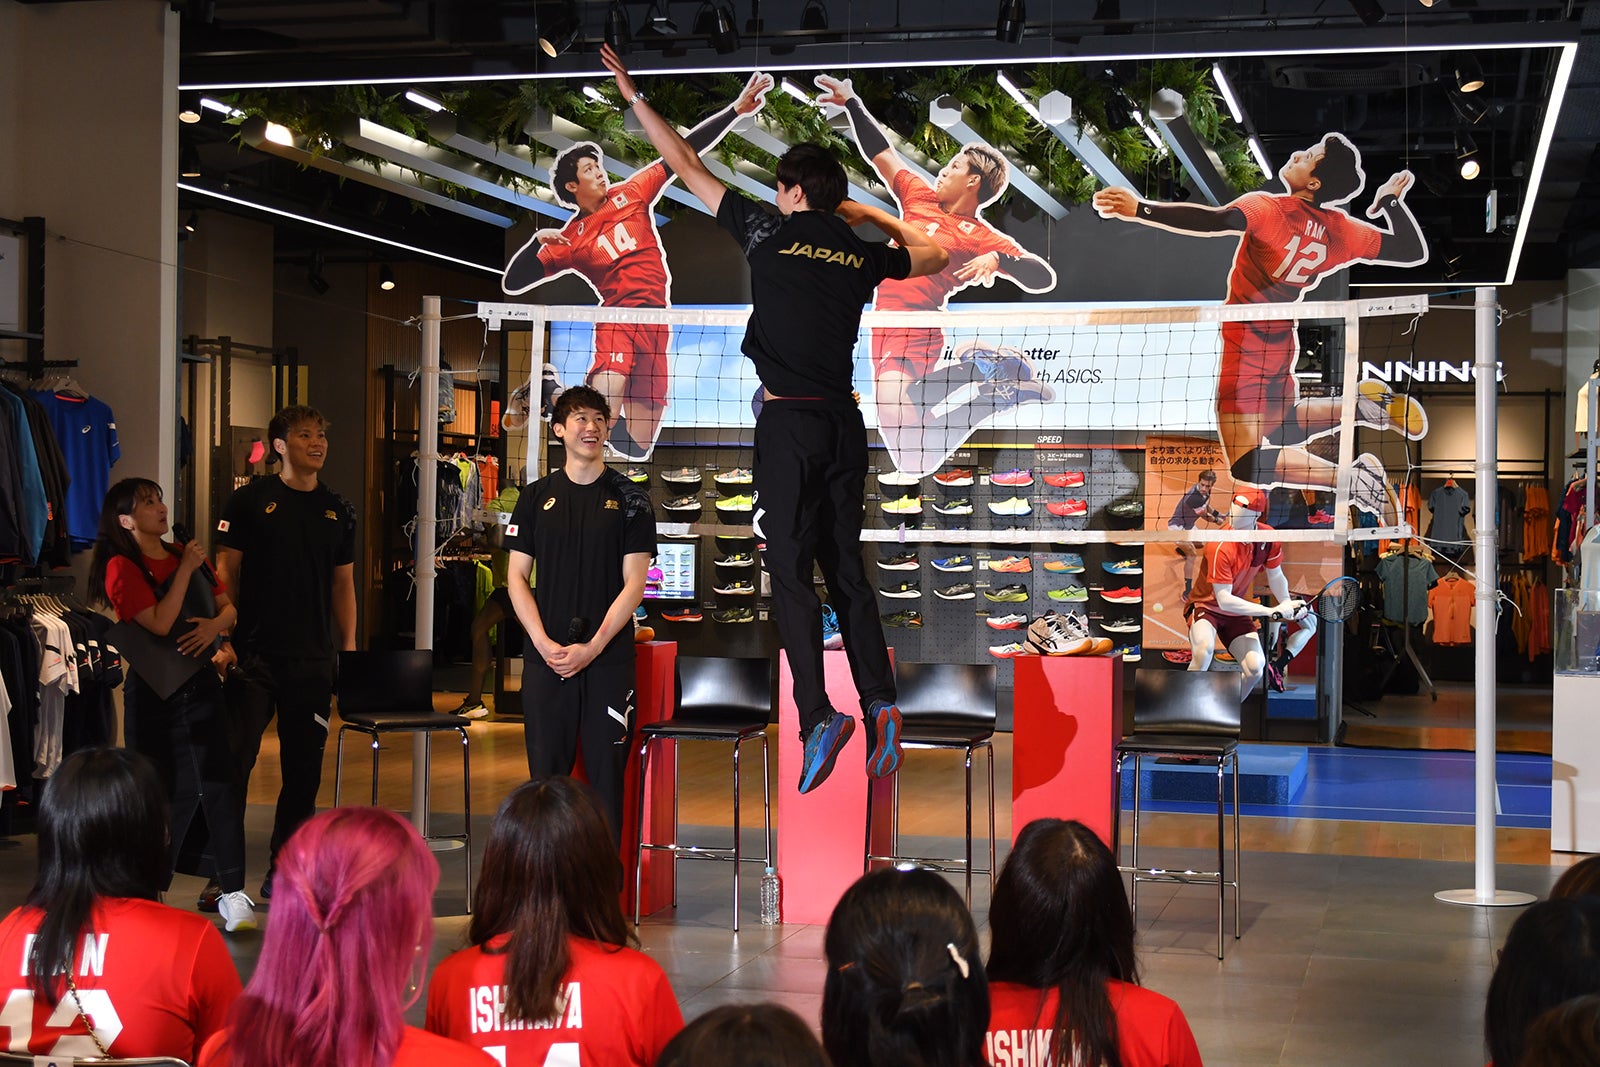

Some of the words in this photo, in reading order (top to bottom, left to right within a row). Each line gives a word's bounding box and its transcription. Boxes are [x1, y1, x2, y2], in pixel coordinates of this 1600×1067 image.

[1304, 220, 1326, 240] RAN
[597, 222, 637, 261] 14
[778, 242, 865, 269] JAPAN
[1271, 235, 1327, 283] 12
[610, 352, 624, 363] 14
[1054, 369, 1104, 384] ASICS.
[1037, 435, 1062, 444] SPEED
[1150, 456, 1224, 465] 自分の求める動きへ
